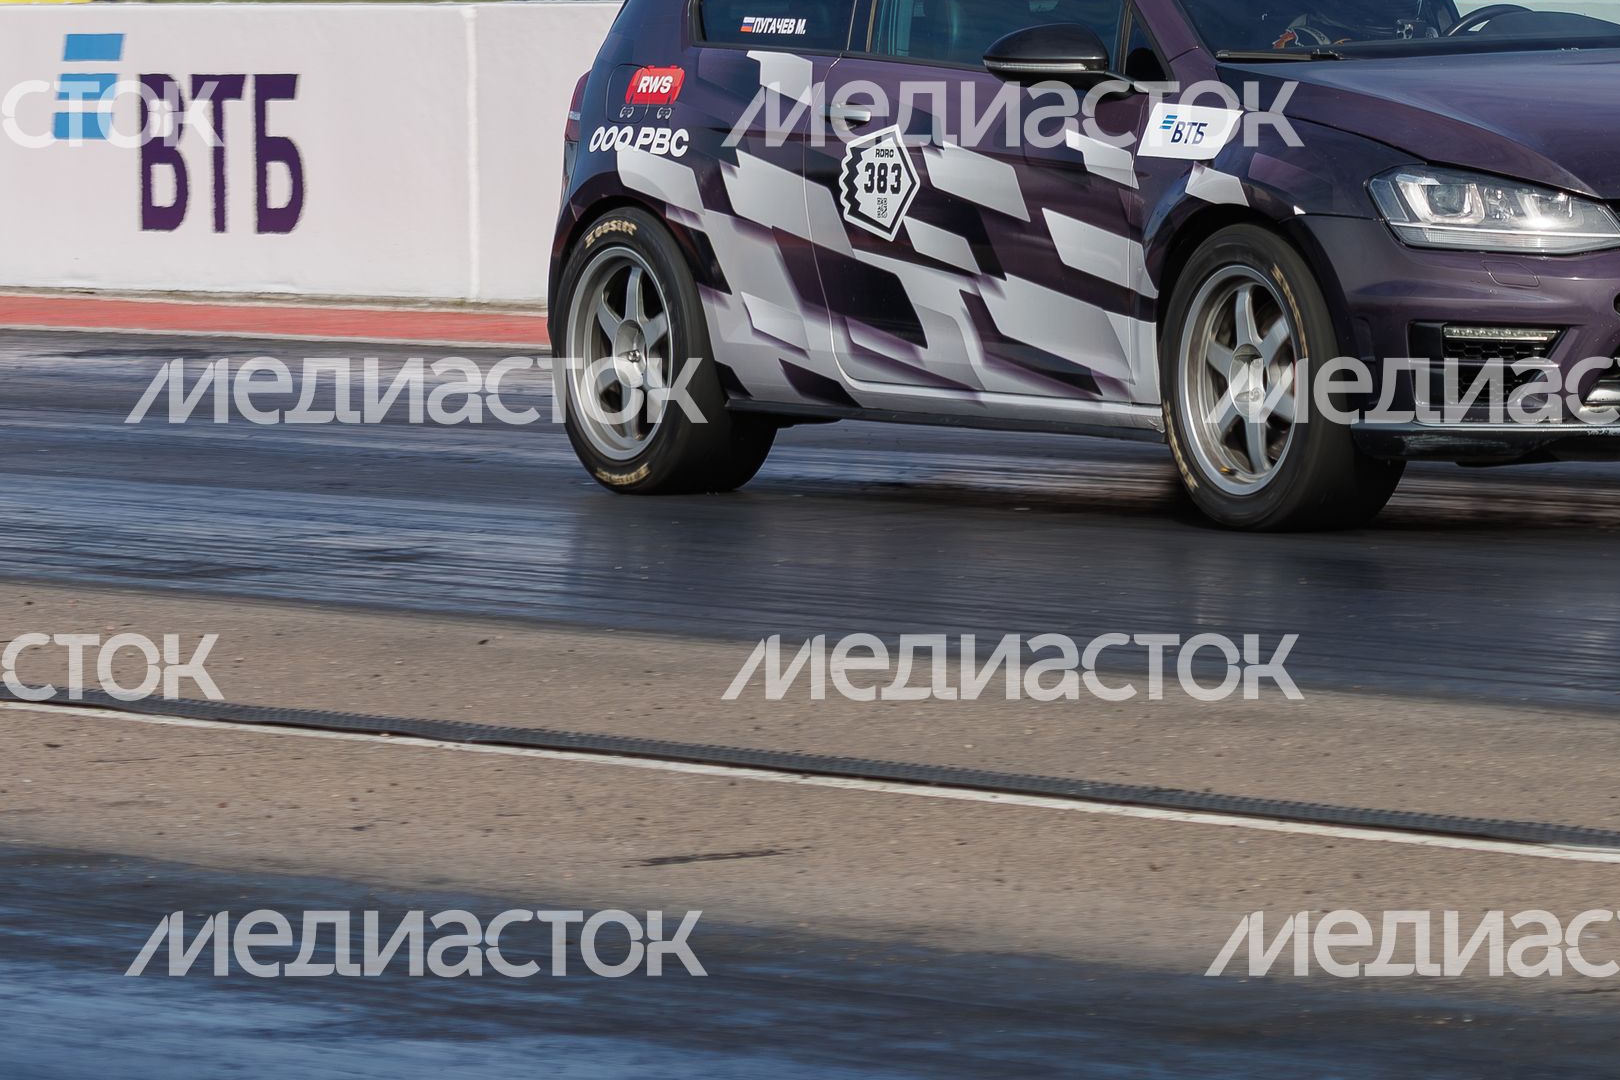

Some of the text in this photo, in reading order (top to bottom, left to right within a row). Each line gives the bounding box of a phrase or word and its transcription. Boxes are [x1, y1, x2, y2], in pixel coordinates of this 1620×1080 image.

[752, 17, 807, 35] ПУГАЧЕВ М.
[636, 75, 674, 94] RWS
[633, 126, 690, 158] РВС
[1170, 121, 1208, 145] ВТБ
[137, 73, 304, 235] ВТБ
[863, 162, 902, 195] 383
